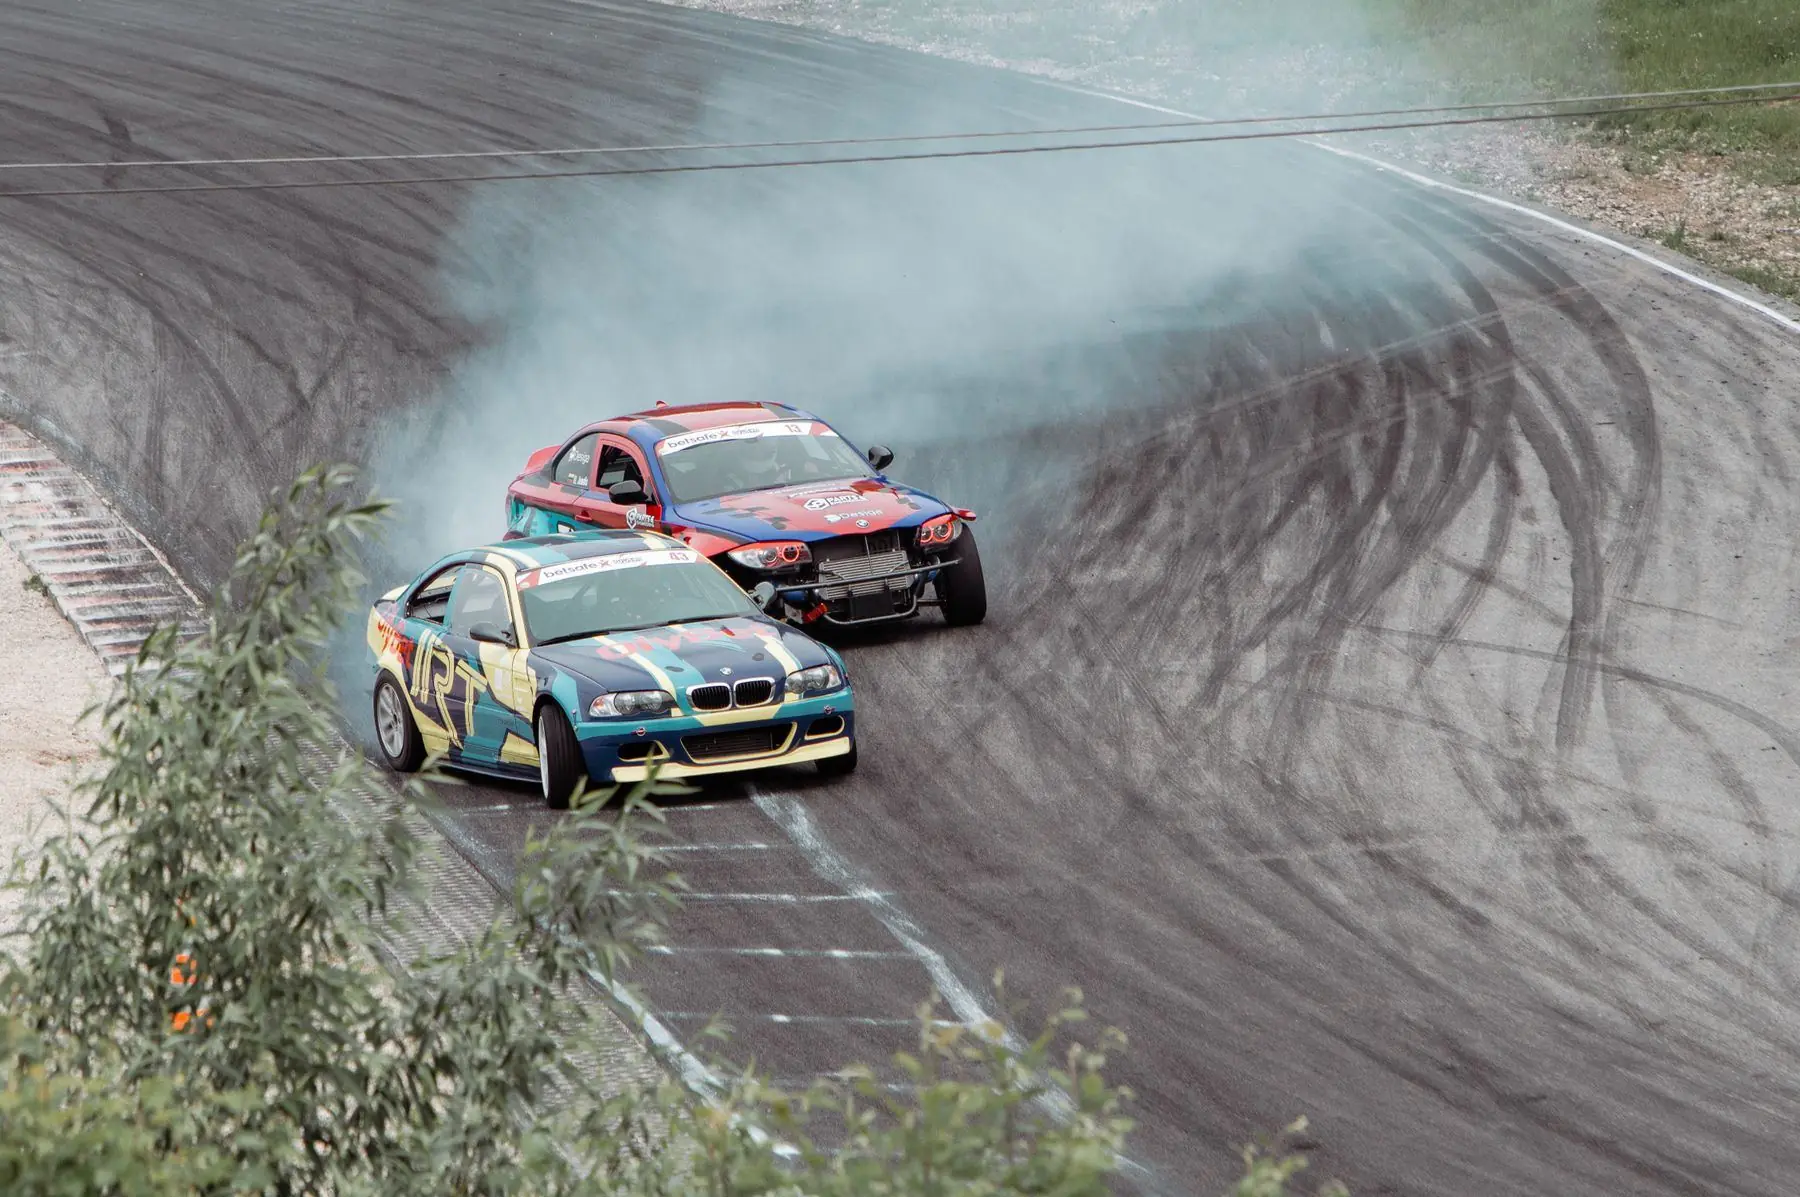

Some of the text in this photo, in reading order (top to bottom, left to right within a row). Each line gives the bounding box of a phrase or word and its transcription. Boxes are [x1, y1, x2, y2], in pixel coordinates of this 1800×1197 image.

[785, 424, 802, 433] 13
[668, 433, 717, 449] betsafe
[669, 552, 689, 561] 43
[543, 563, 597, 578] betsafe
